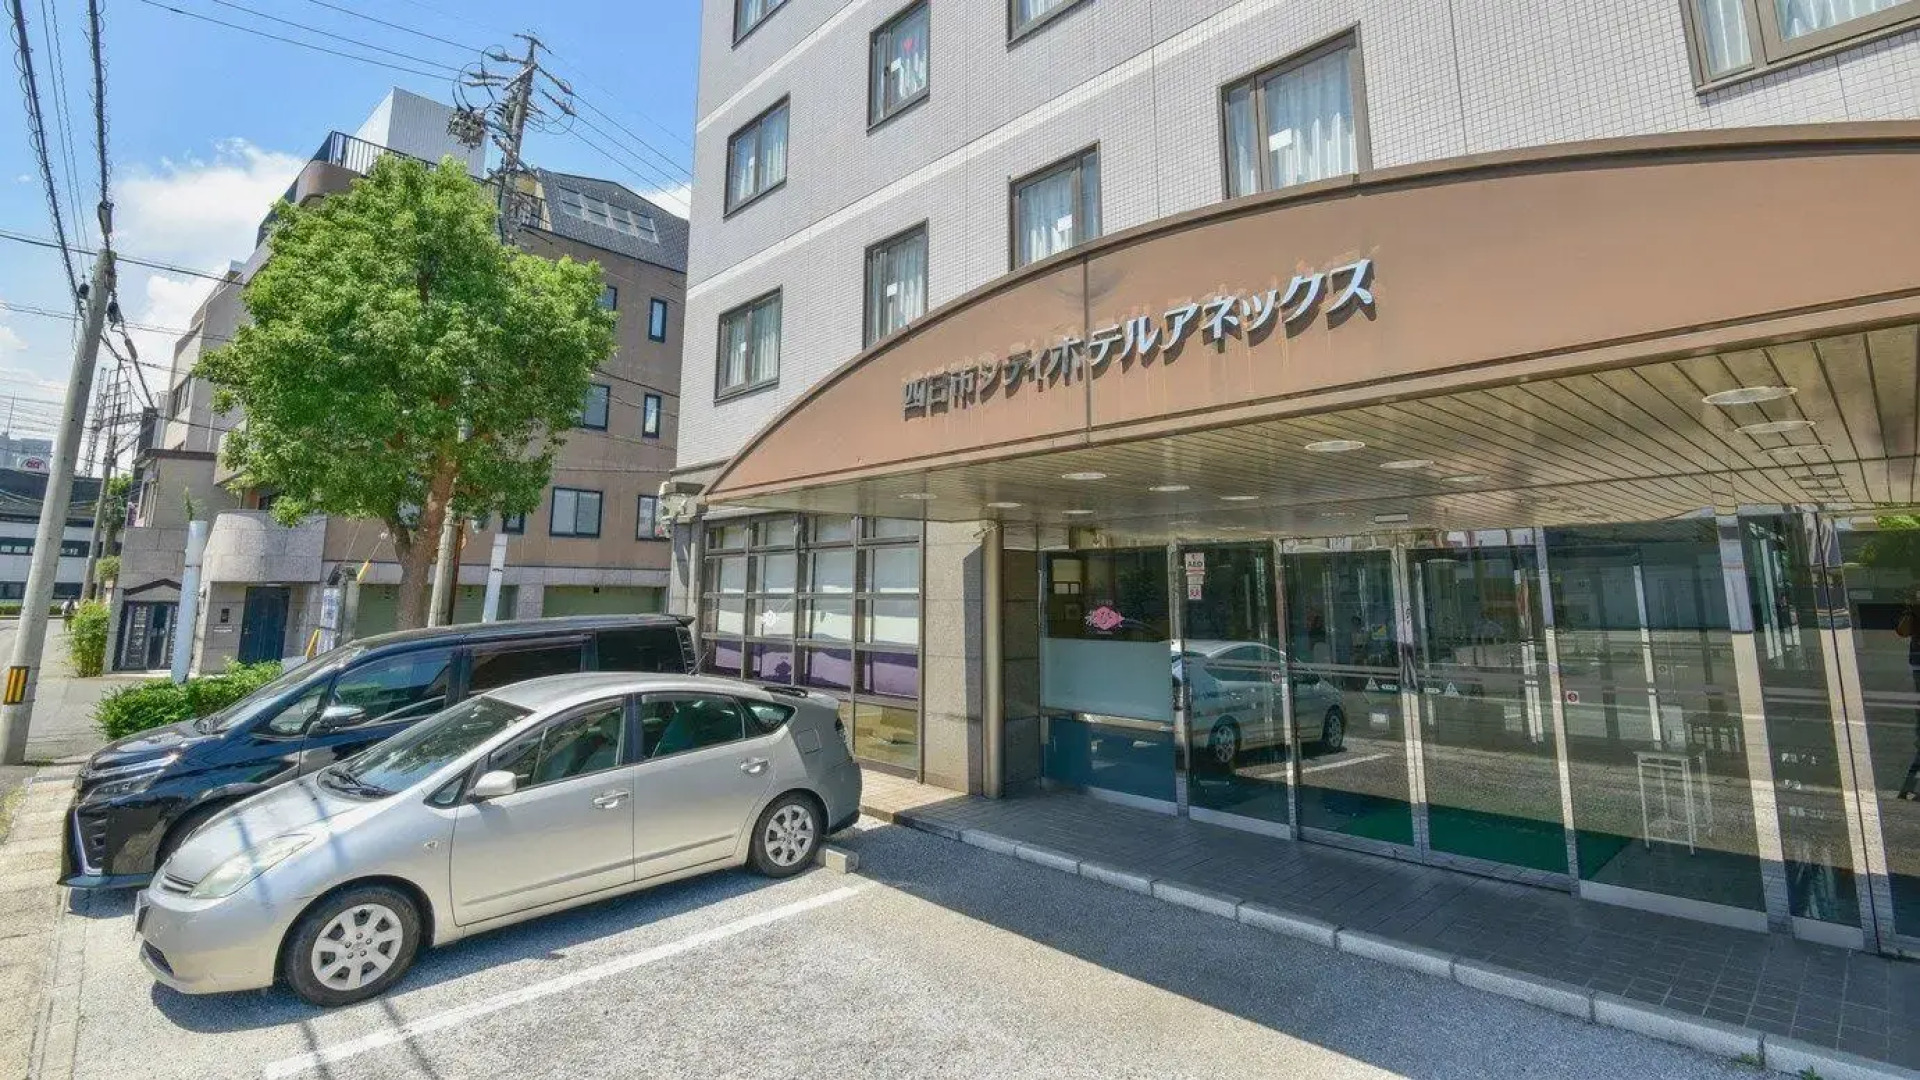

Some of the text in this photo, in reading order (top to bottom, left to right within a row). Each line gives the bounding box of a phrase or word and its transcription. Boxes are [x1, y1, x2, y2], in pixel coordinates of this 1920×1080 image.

[904, 258, 1374, 410] 四日市シティホテルアネックス
